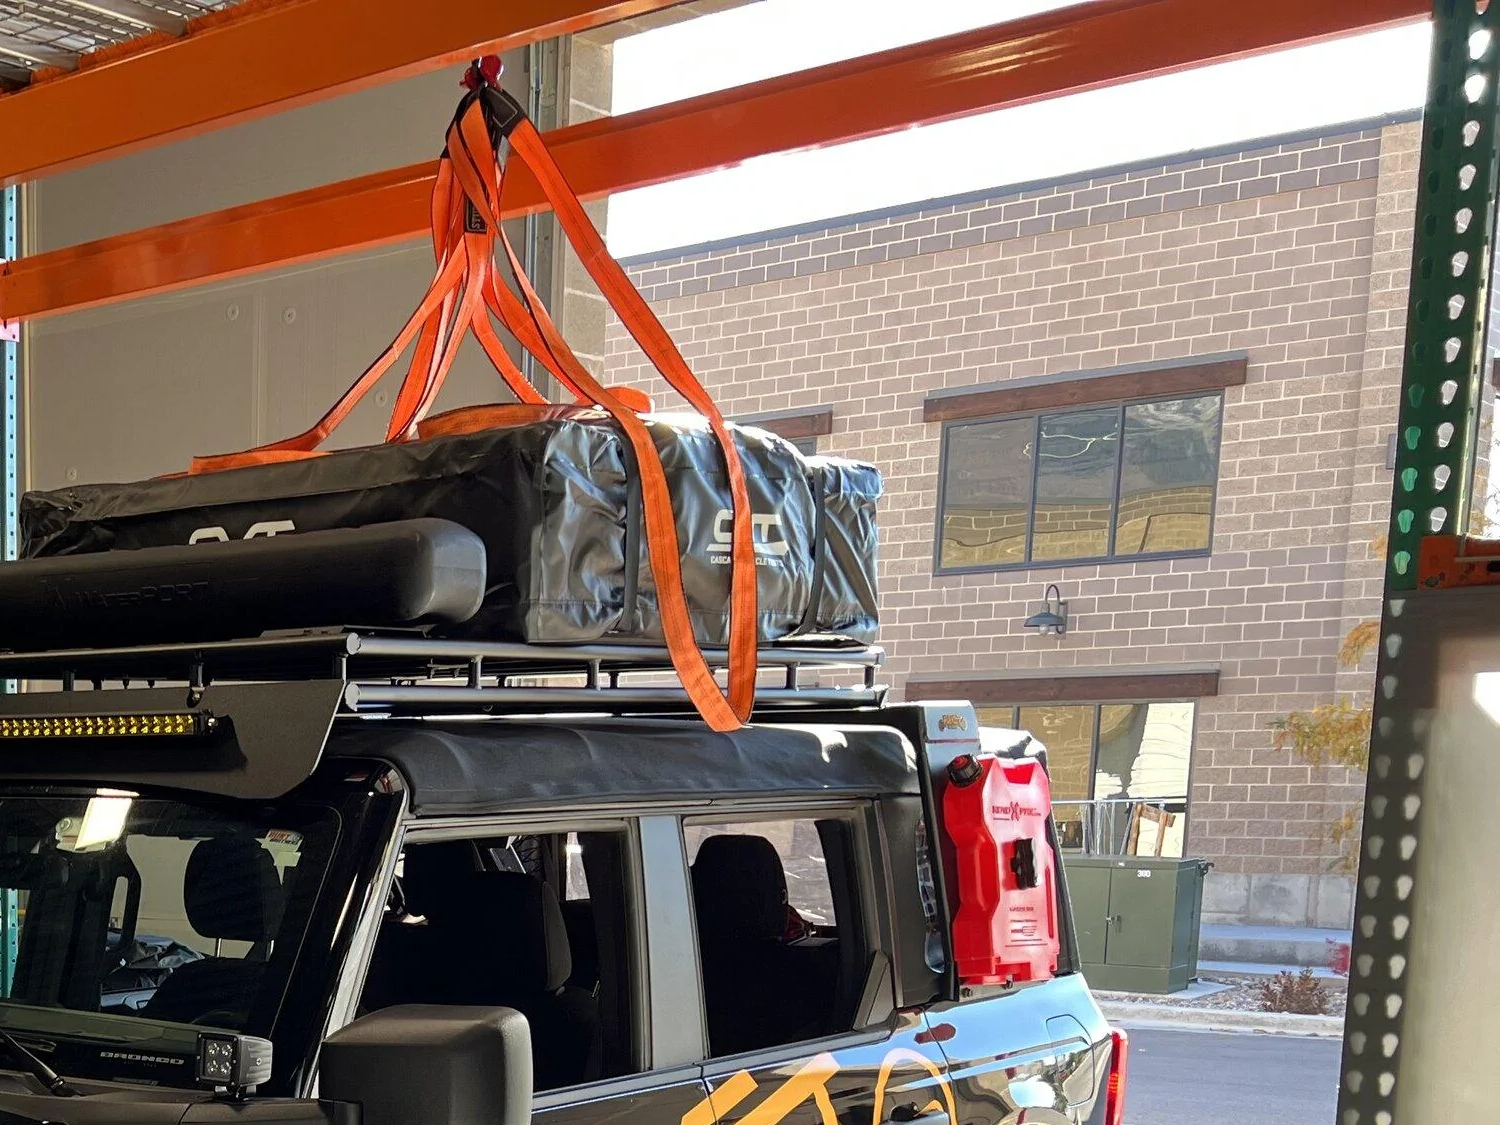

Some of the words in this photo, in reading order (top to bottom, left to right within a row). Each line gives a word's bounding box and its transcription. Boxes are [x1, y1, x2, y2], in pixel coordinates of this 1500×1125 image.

[710, 556, 732, 565] CASCA
[1137, 869, 1152, 878] 300
[100, 1050, 185, 1066] BRONCO
